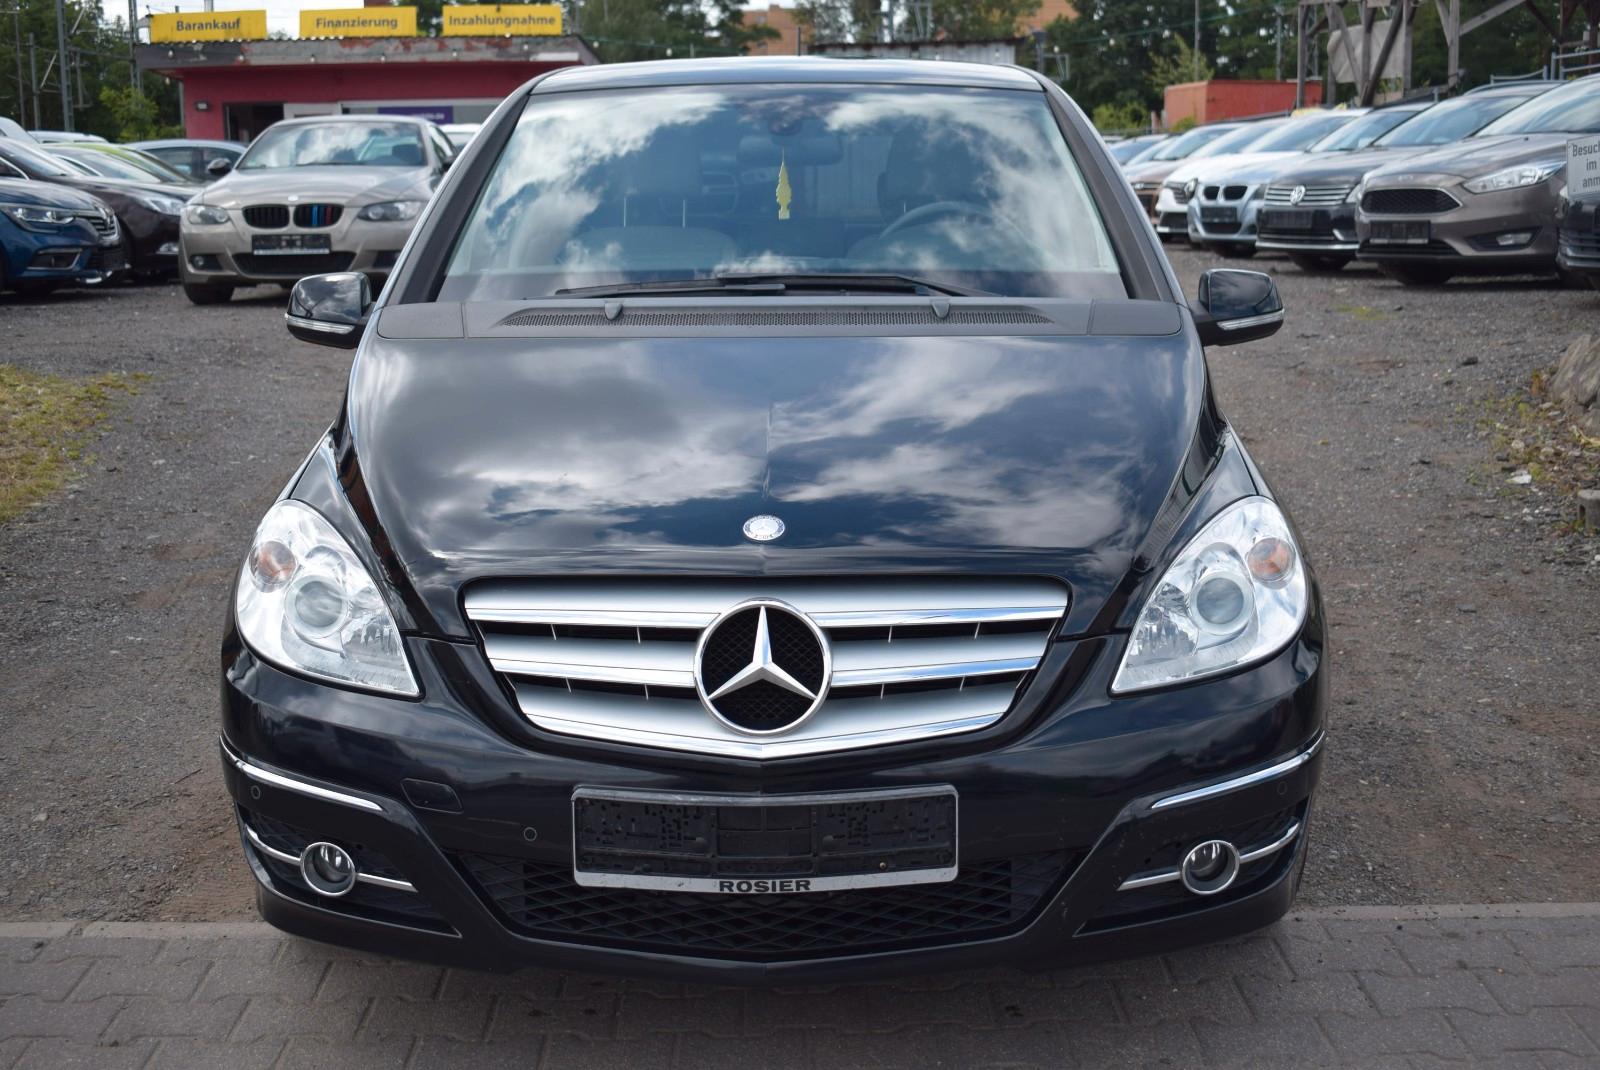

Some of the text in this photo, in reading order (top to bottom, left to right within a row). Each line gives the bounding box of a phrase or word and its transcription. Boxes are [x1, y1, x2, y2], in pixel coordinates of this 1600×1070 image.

[176, 18, 241, 31] Barankauf
[316, 16, 398, 30] Finanzierung
[449, 14, 555, 28] Inzahlungnahme
[1586, 157, 1597, 171] im
[719, 880, 812, 893] ROSIER
